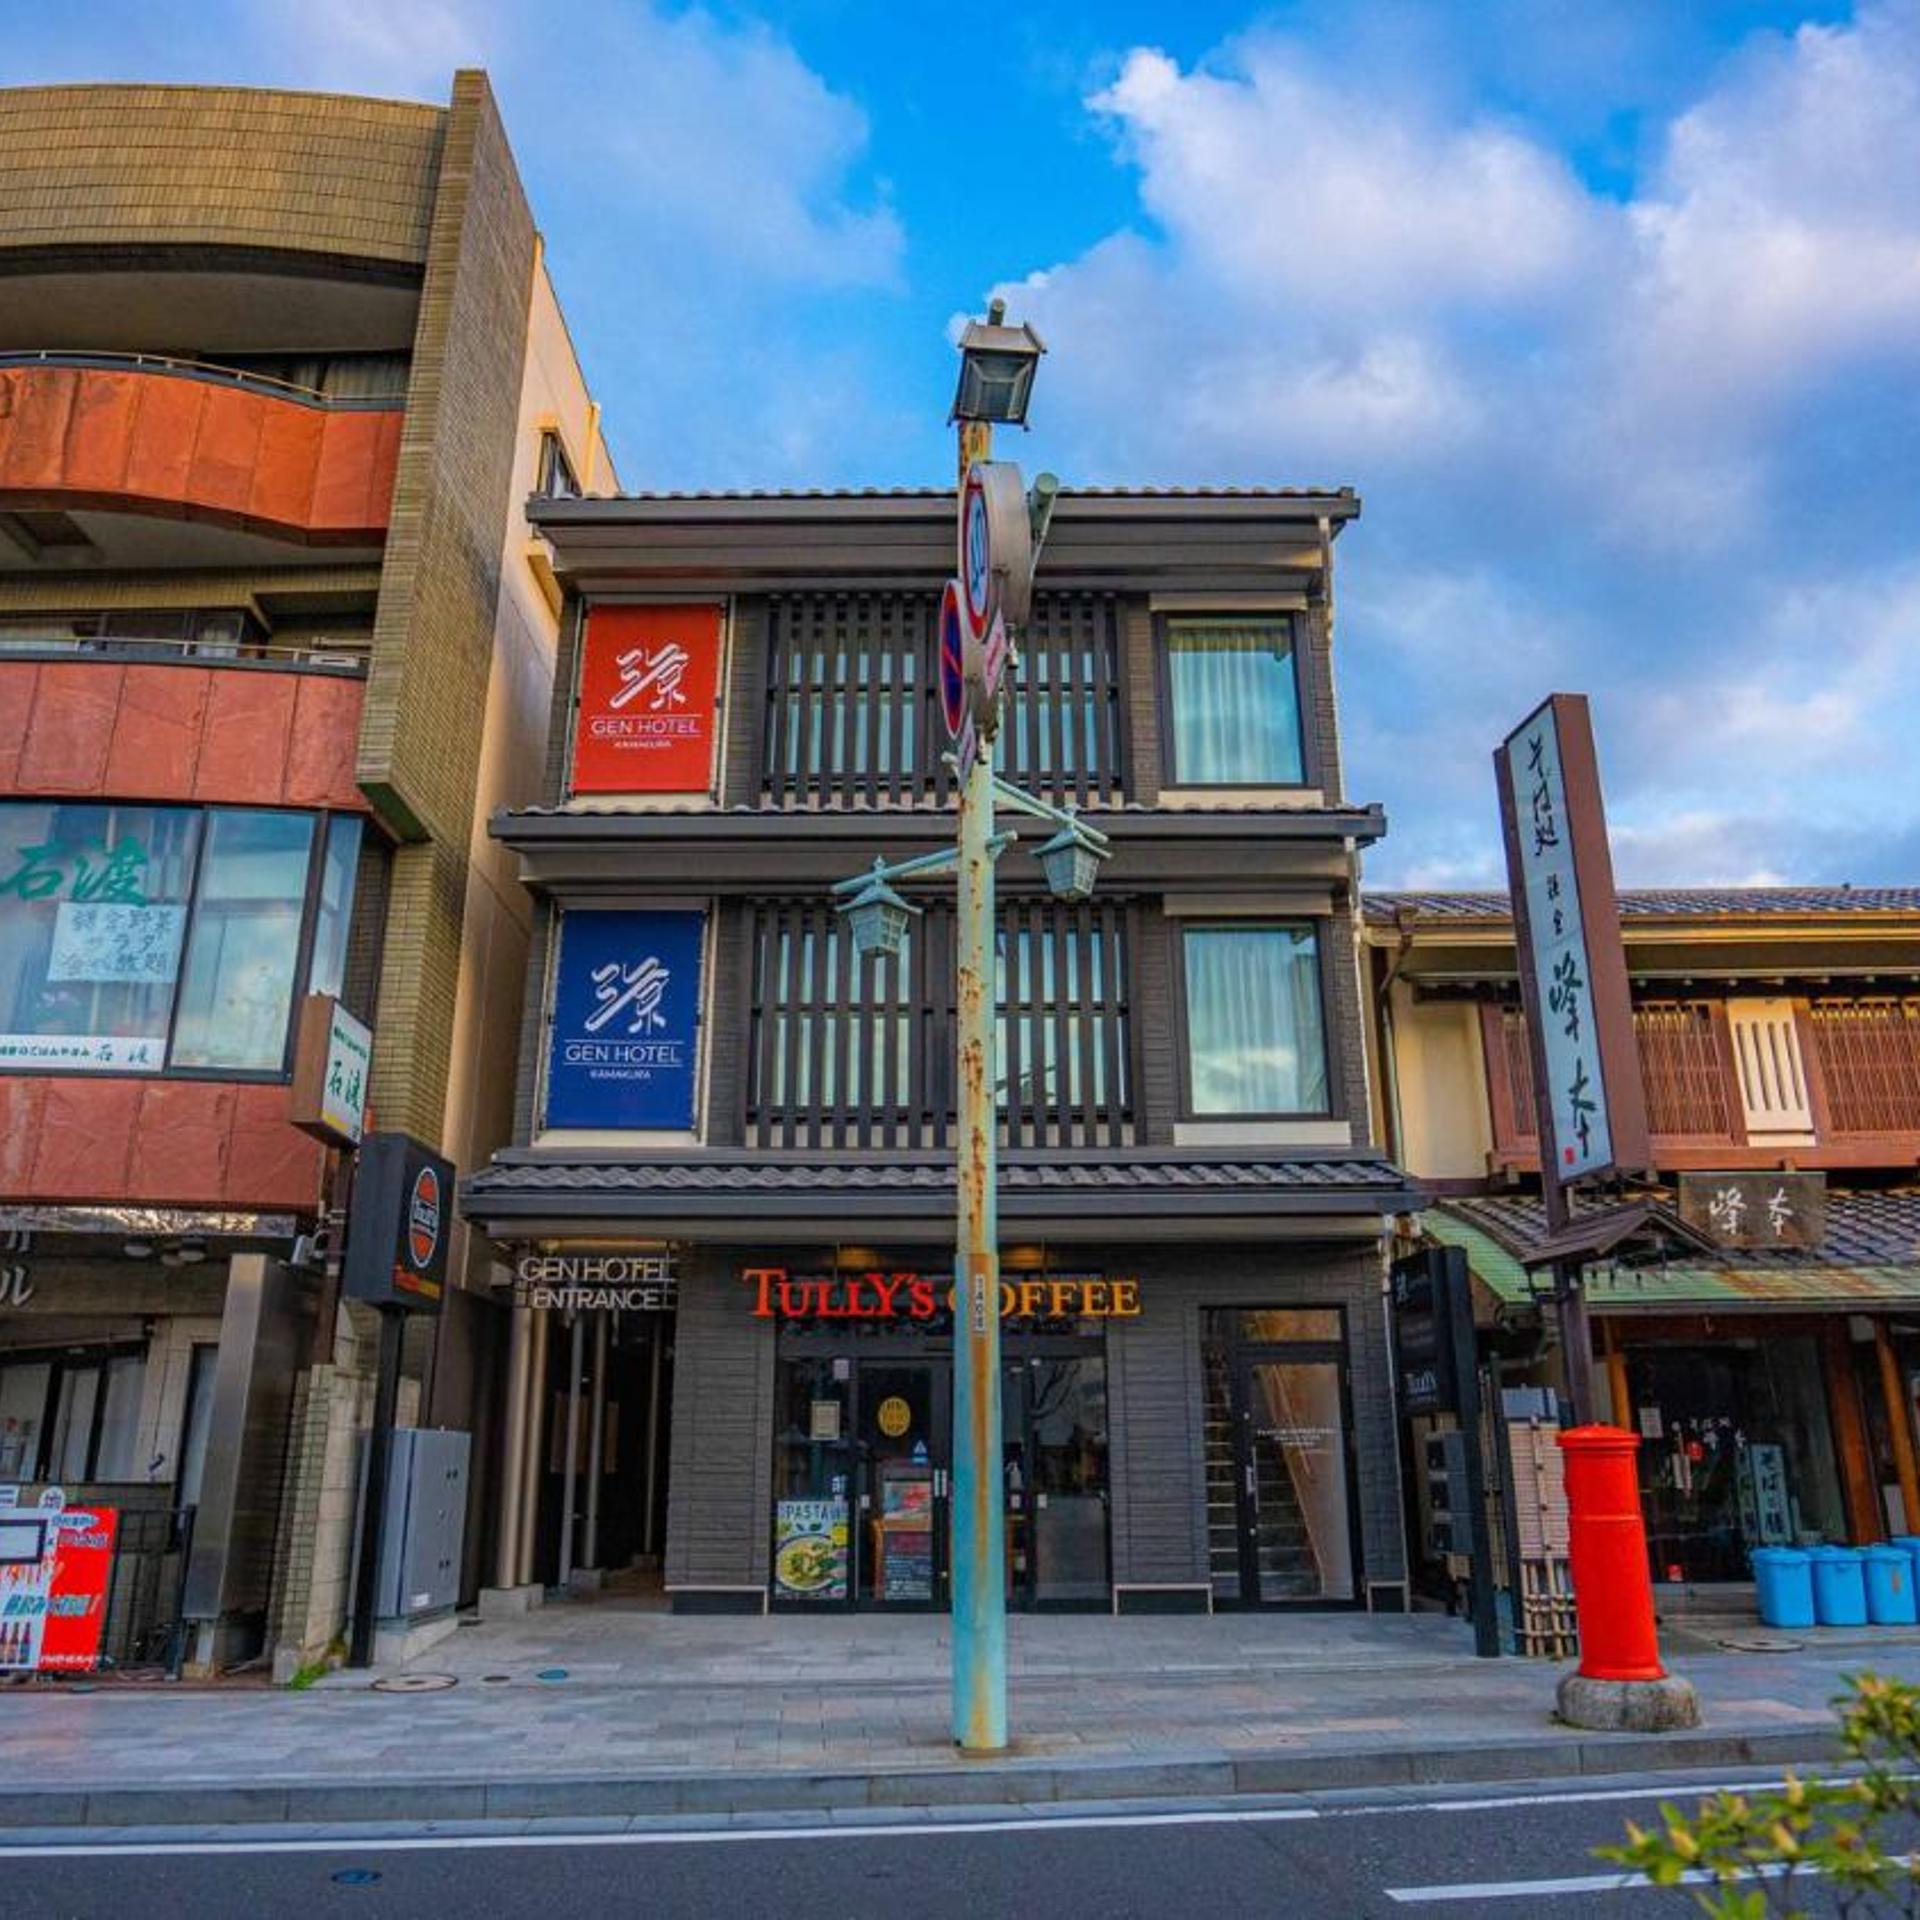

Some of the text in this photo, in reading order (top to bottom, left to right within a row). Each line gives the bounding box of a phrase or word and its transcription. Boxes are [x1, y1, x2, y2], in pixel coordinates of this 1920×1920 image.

[591, 720, 702, 734] GEN HOTEL
[566, 1046, 681, 1063] GEN HOTEL
[519, 1257, 676, 1282] GEN HOTEL
[533, 1288, 662, 1310] ENTRANCE
[948, 1280, 1141, 1316] FFEE
